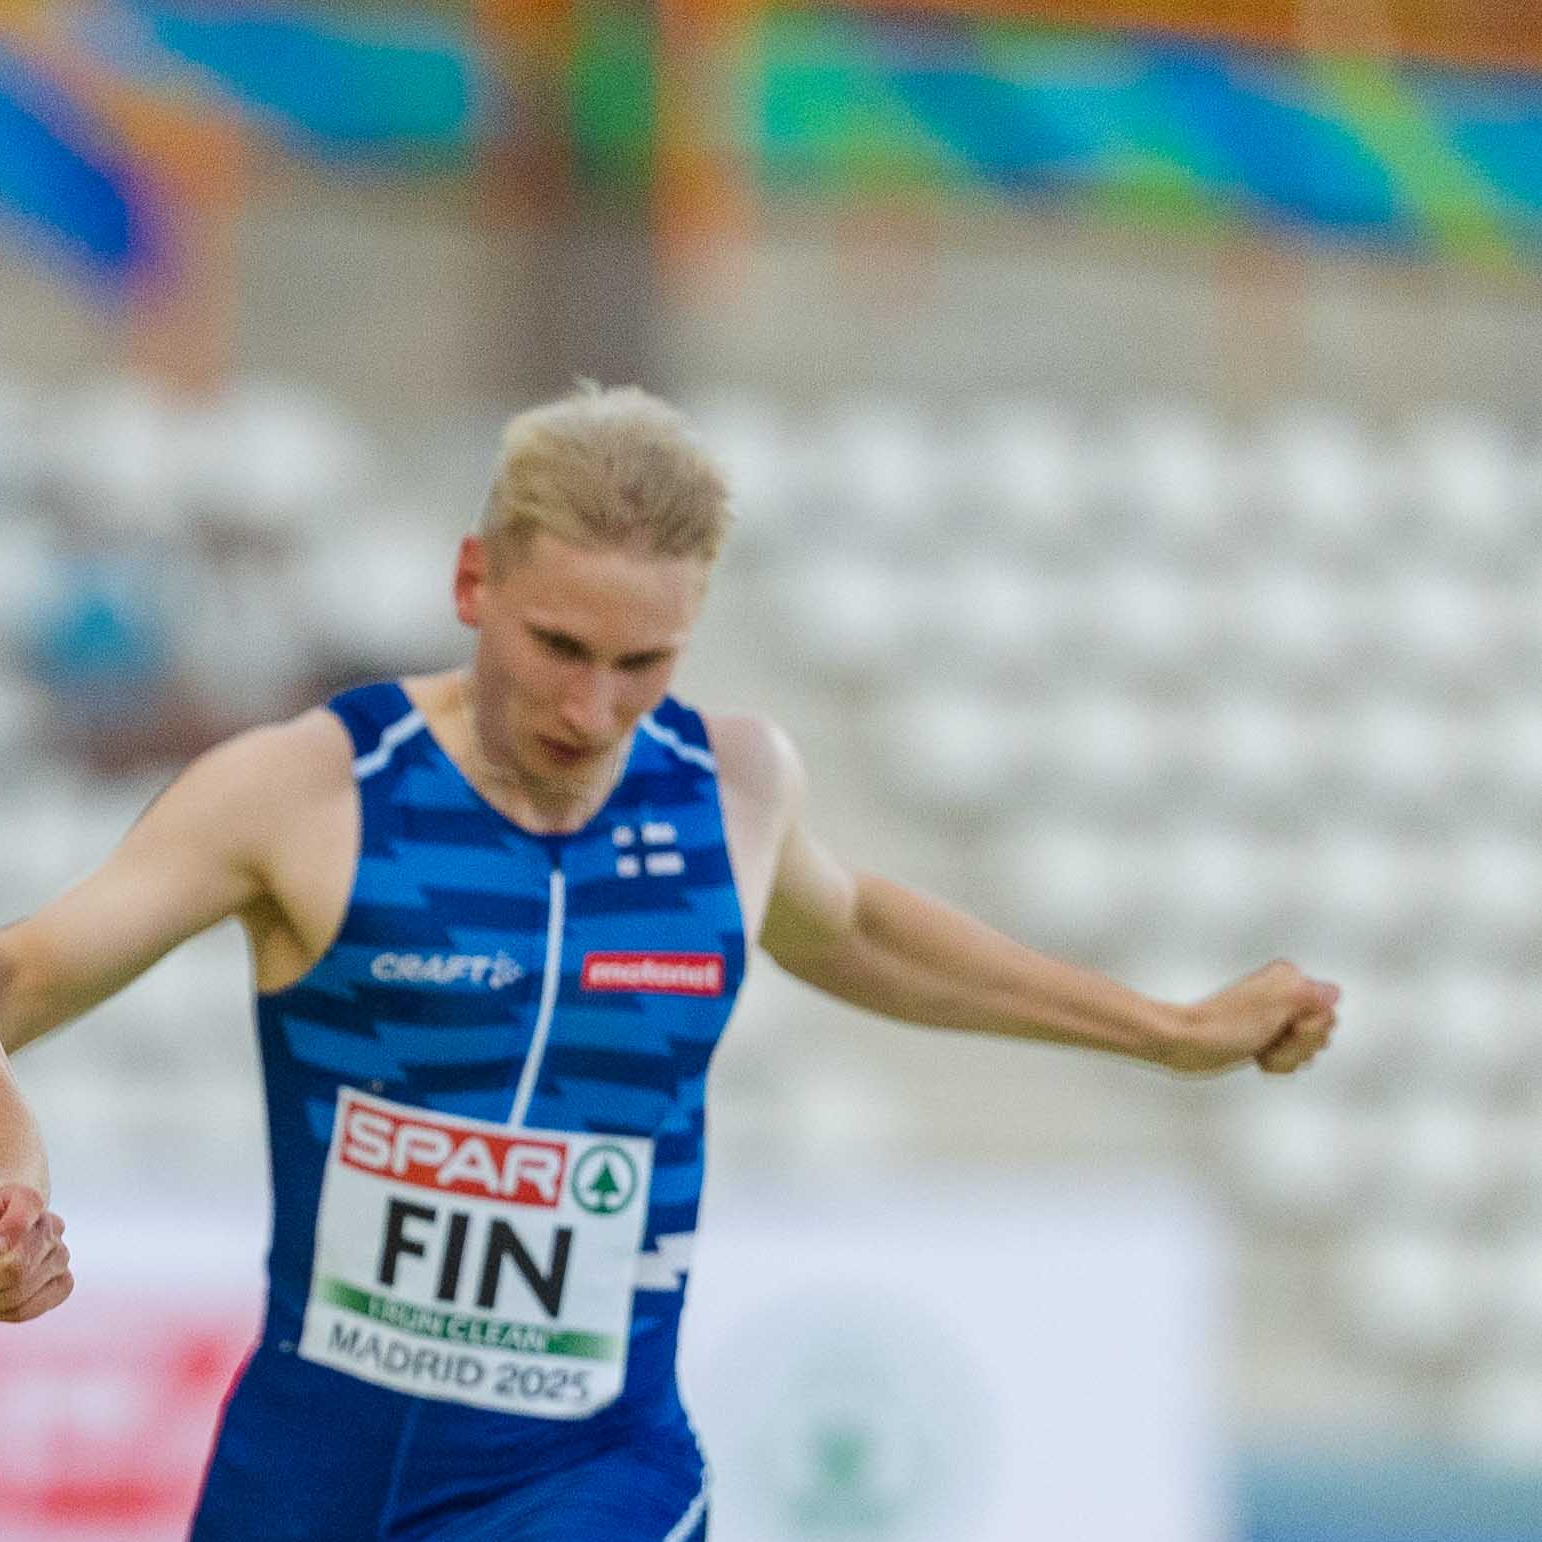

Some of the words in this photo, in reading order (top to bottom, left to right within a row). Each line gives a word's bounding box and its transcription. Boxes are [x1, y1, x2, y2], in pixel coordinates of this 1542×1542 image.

[347, 1110, 562, 1202] SPAR
[378, 1198, 573, 1318] FIN
[328, 1322, 484, 1387] MADRID
[495, 1362, 591, 1400] 2025
[448, 1317, 549, 1352] CLEAN
